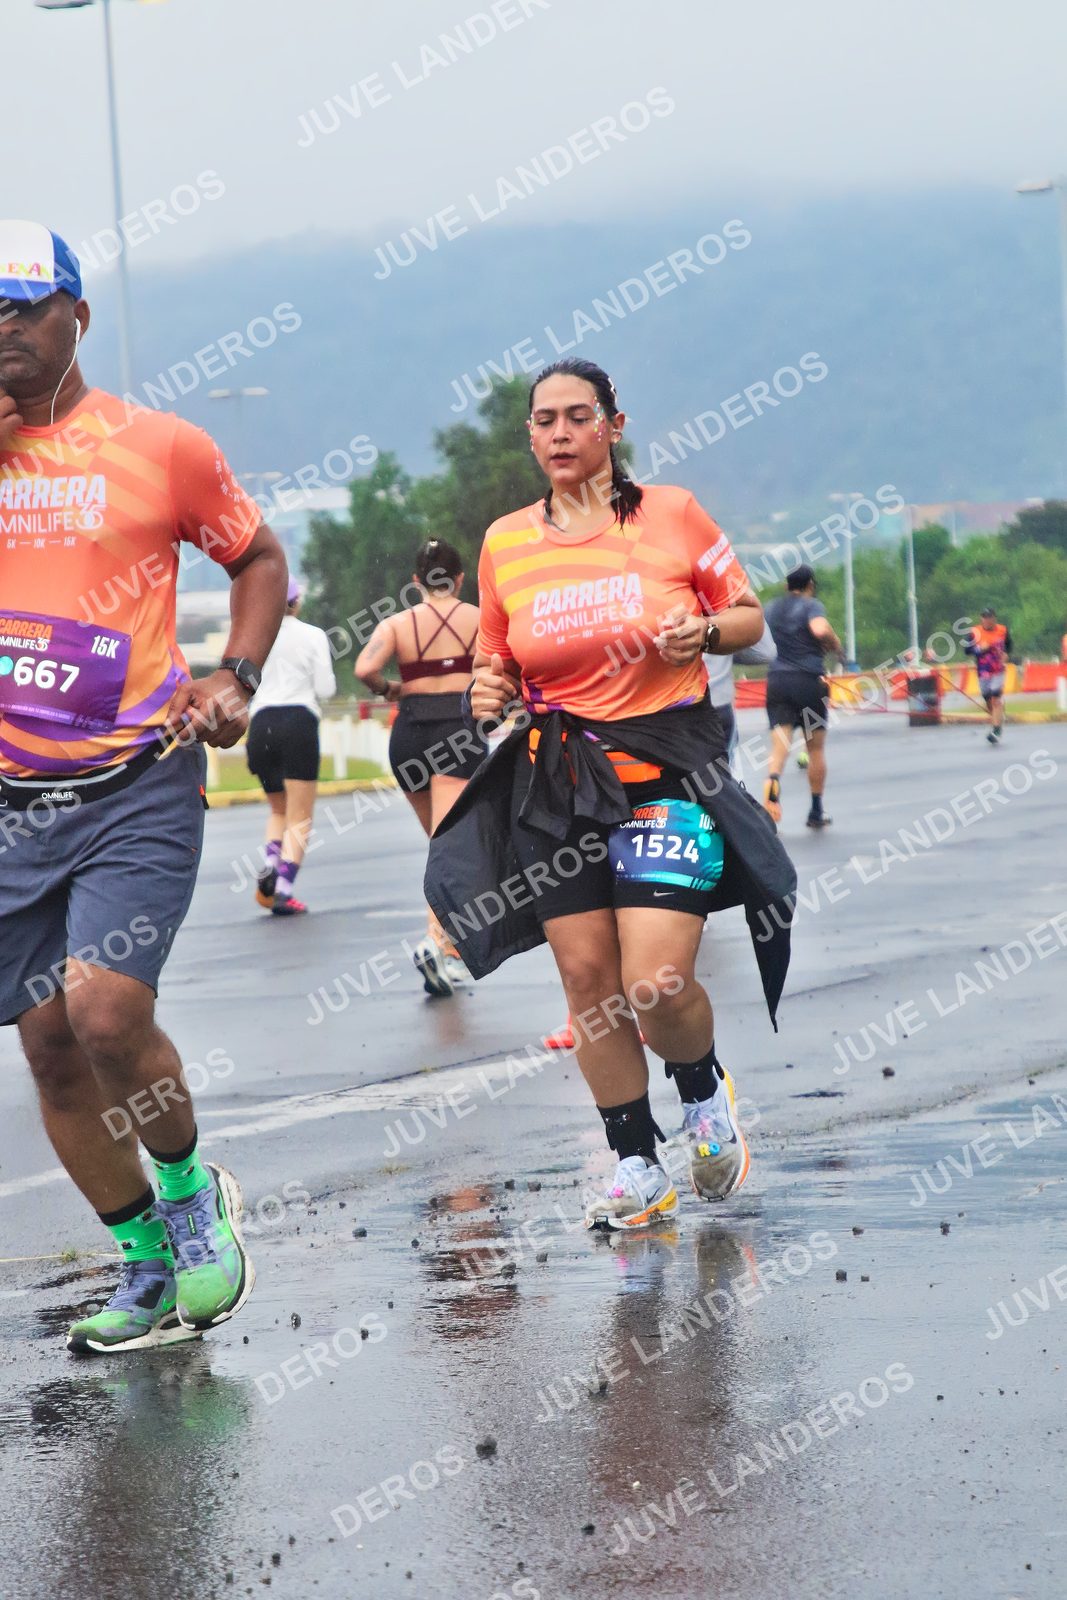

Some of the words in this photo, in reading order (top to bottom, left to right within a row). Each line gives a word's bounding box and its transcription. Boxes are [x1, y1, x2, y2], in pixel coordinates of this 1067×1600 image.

[0, 474, 107, 509] ARRERA
[0, 511, 74, 533] MNILIFE
[532, 572, 642, 618] CARRERA
[531, 605, 620, 637] OMNILIFE
[0, 635, 36, 650] MNILIFE
[91, 635, 120, 659] 15K
[13, 656, 80, 693] 667
[632, 806, 669, 821] RRERA
[631, 834, 700, 864] 1524
